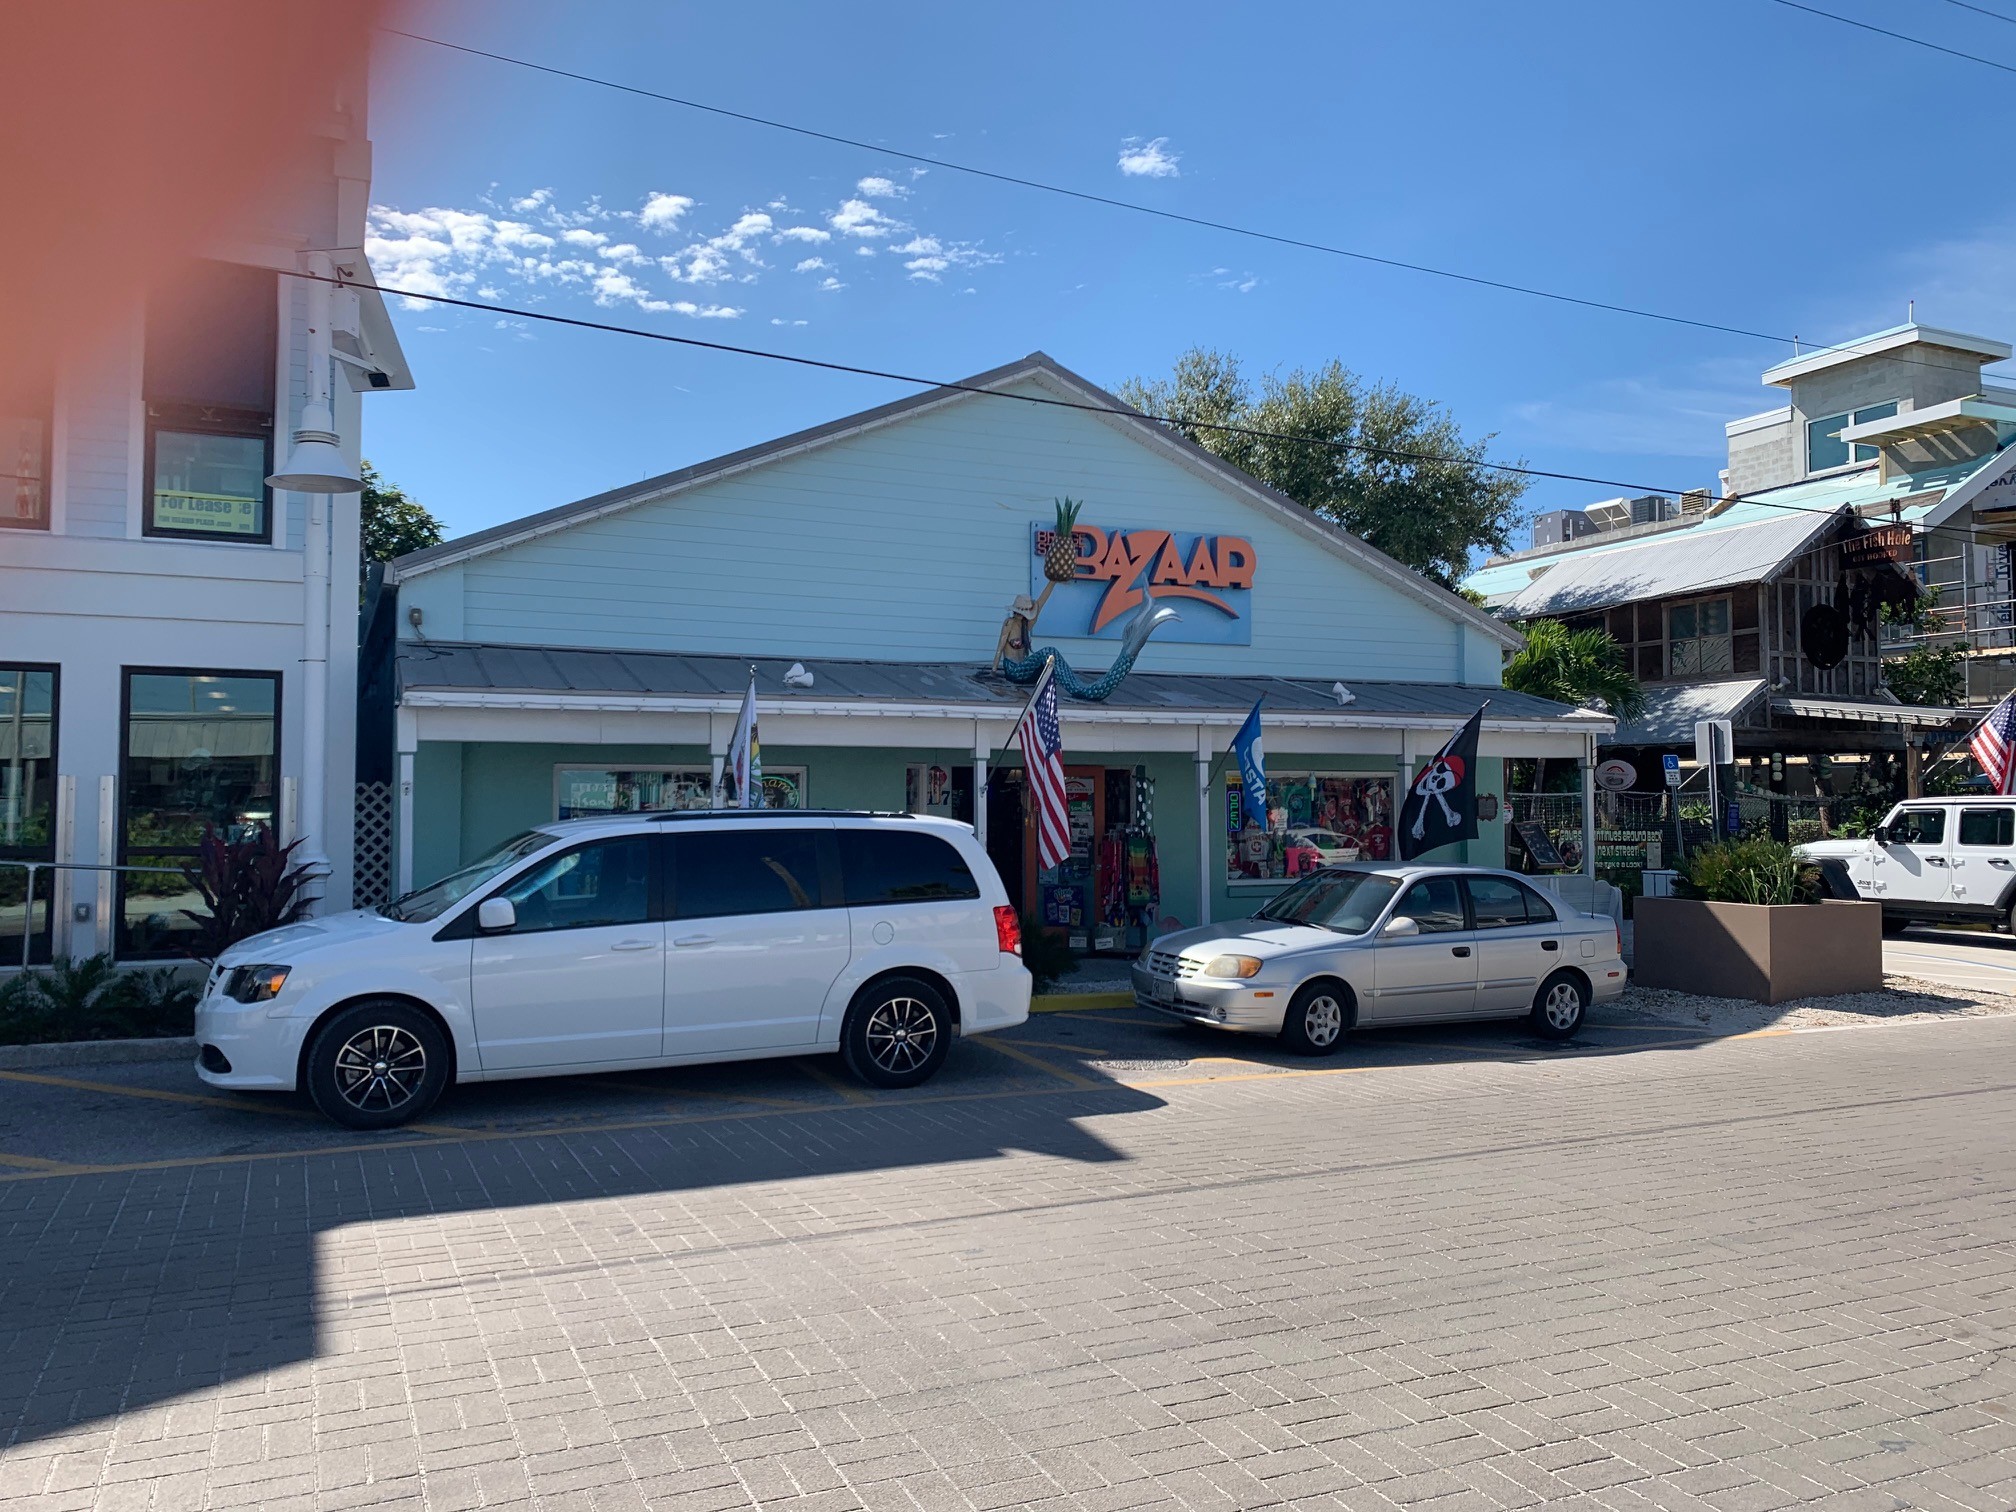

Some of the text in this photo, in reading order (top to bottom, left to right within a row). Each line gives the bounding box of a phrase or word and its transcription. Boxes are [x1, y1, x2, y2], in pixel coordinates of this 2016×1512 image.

[188, 497, 232, 514] Lease
[1862, 532, 1885, 549] Fish
[1887, 530, 1911, 545] Hole
[1072, 524, 1257, 634] BAZAAR
[1229, 793, 1239, 829] OPEN
